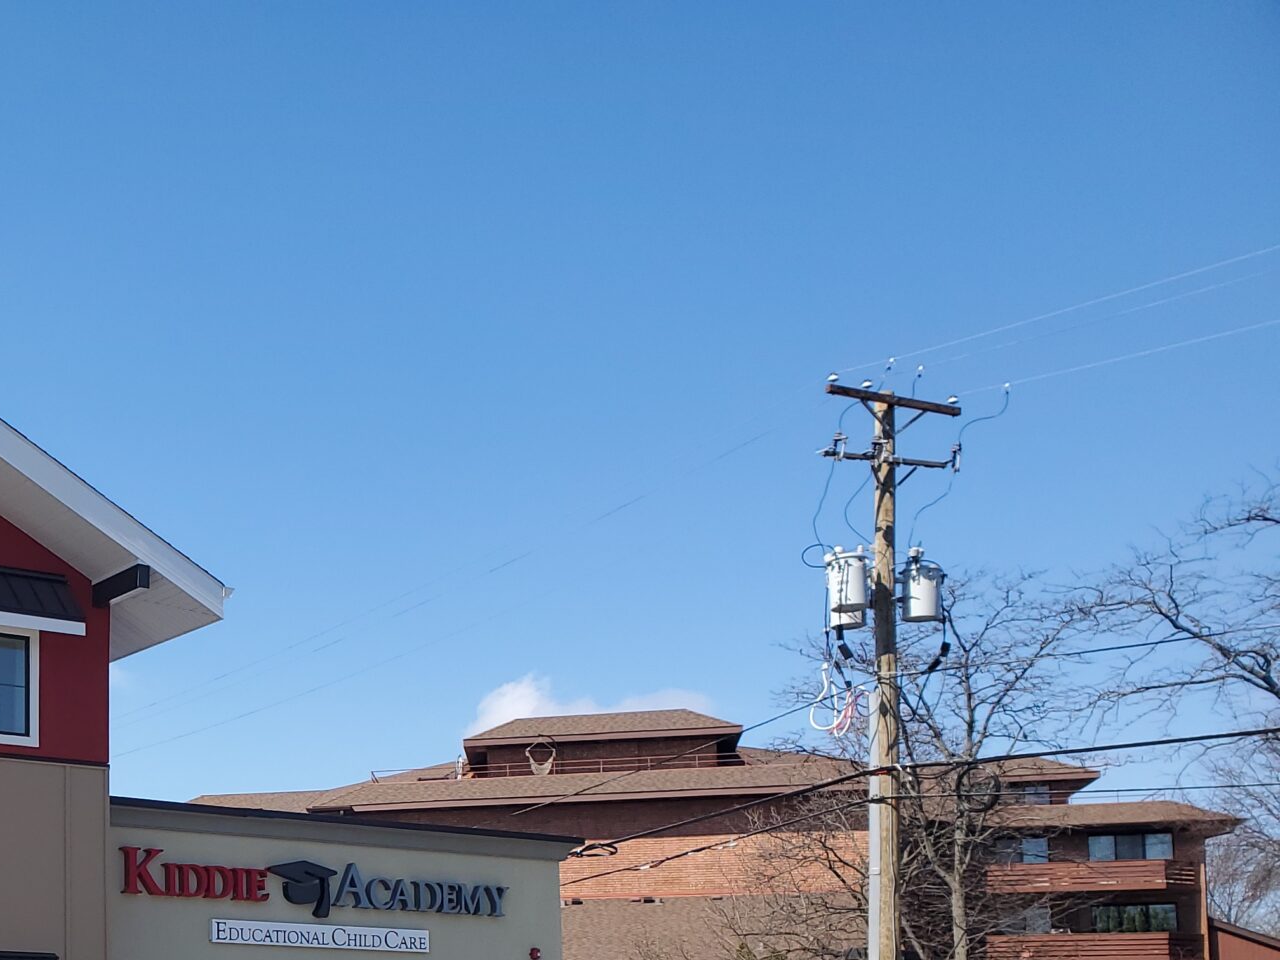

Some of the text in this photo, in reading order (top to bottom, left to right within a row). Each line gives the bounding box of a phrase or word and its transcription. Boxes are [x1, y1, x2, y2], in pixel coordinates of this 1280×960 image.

[118, 845, 510, 917] KIDDIE ACADEMY
[215, 921, 428, 951] EDUCATIONAL CHILD CARE
